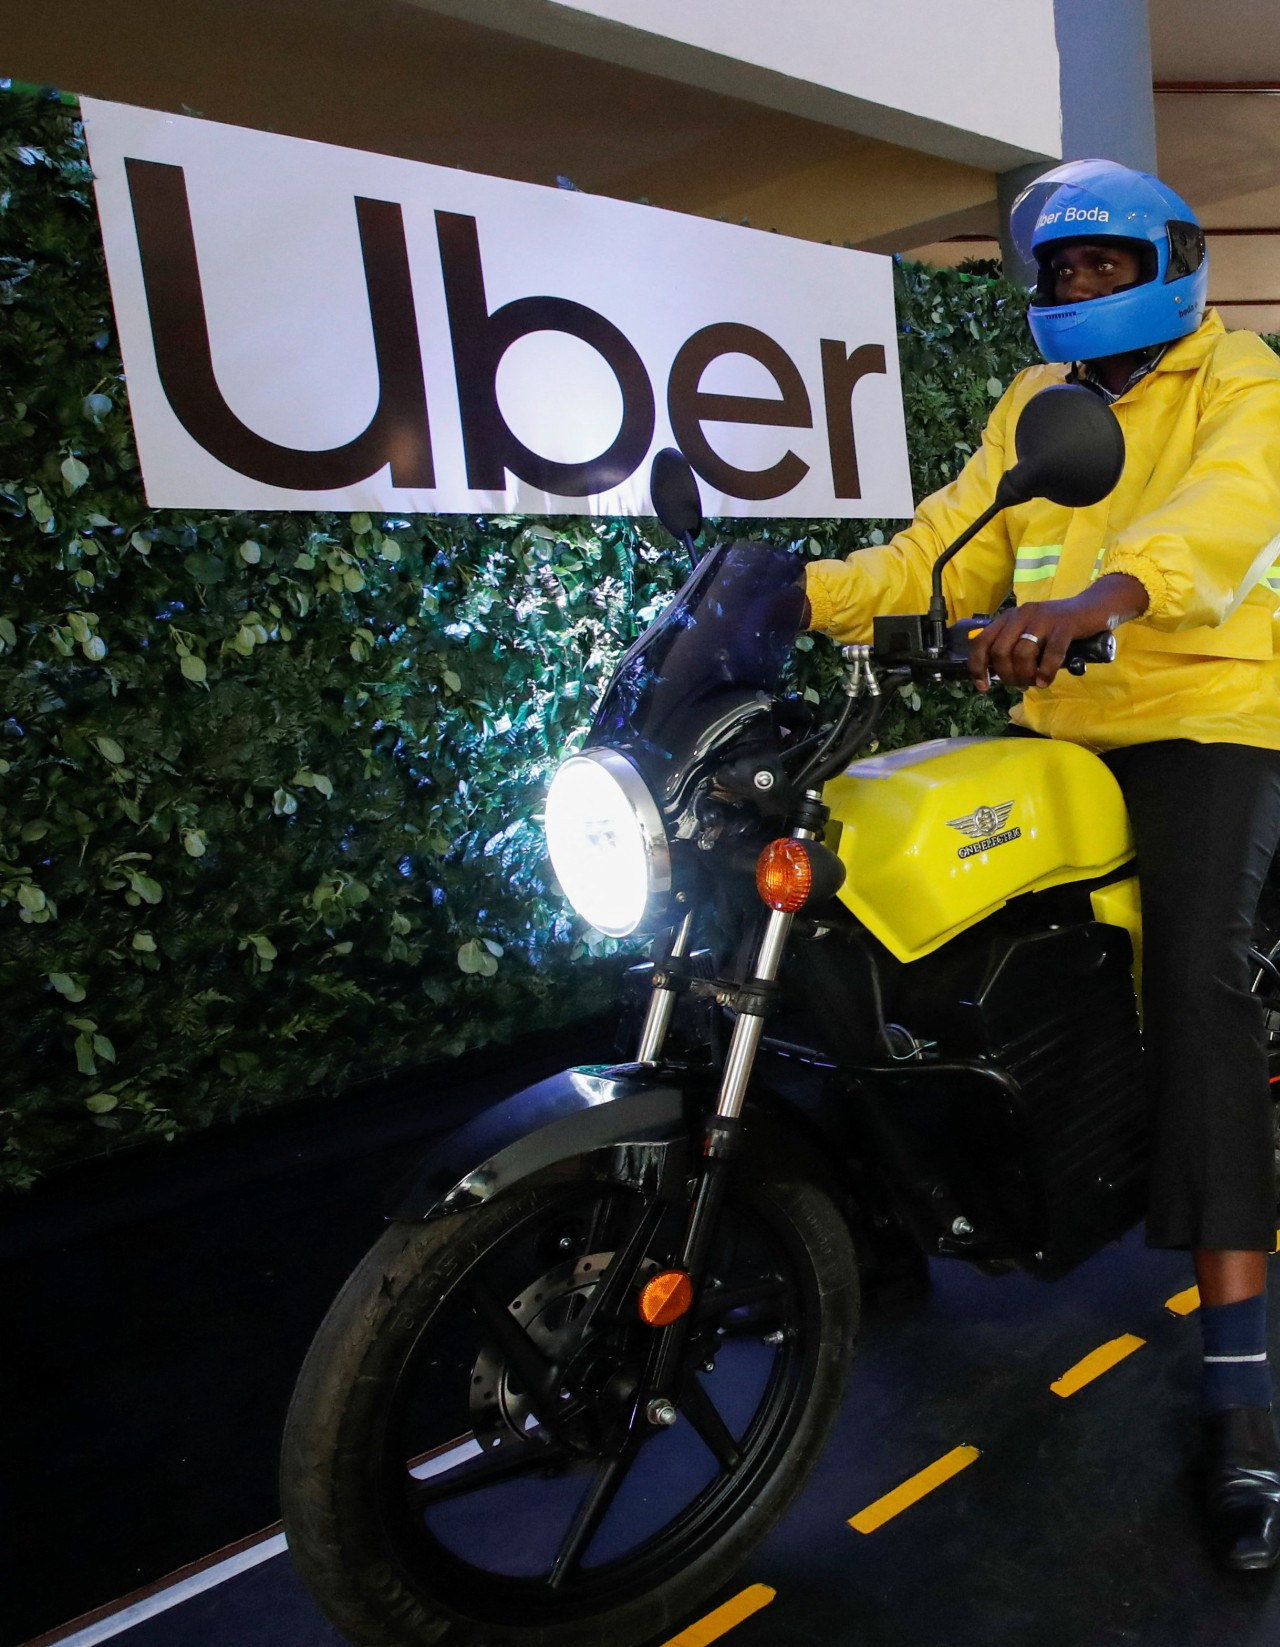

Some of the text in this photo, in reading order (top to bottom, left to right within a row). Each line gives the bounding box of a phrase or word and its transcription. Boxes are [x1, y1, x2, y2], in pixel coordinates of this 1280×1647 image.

[1065, 207, 1109, 222] Boda
[124, 156, 886, 500] Uber
[958, 828, 1020, 858] ONE ELECTRIC
